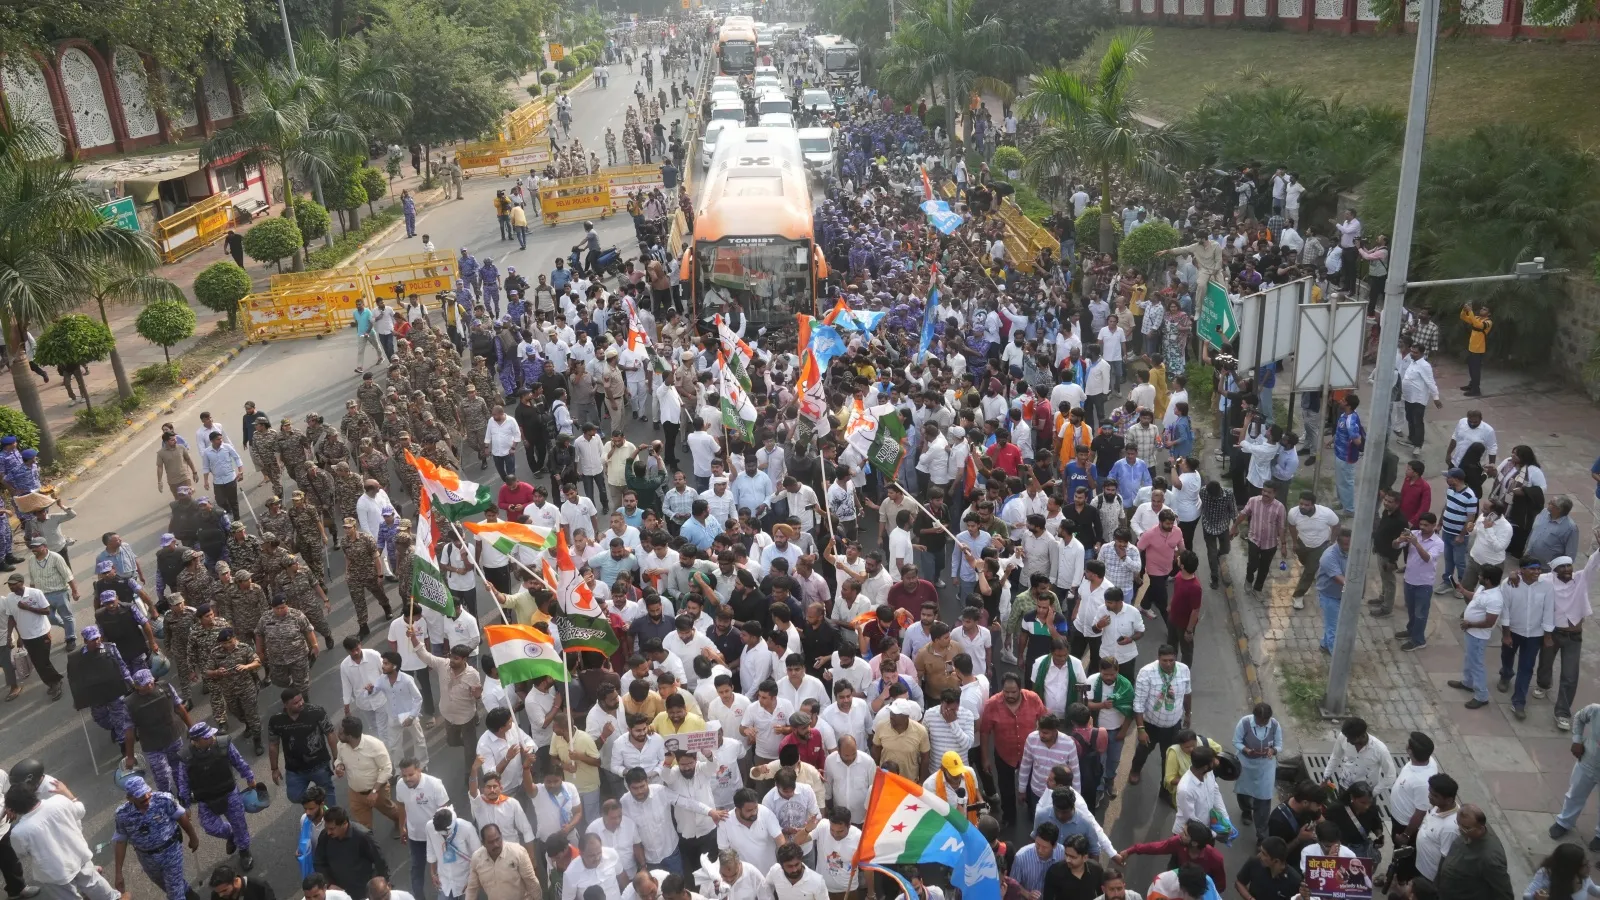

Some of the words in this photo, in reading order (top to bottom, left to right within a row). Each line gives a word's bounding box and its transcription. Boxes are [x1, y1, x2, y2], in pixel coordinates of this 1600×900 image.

[572, 197, 591, 205] POLICE
[409, 281, 433, 290] POLICE
[1308, 859, 1320, 868] वोट
[1321, 859, 1336, 868] चोरी
[1320, 868, 1334, 878] कैसे
[1319, 877, 1326, 891] ?
